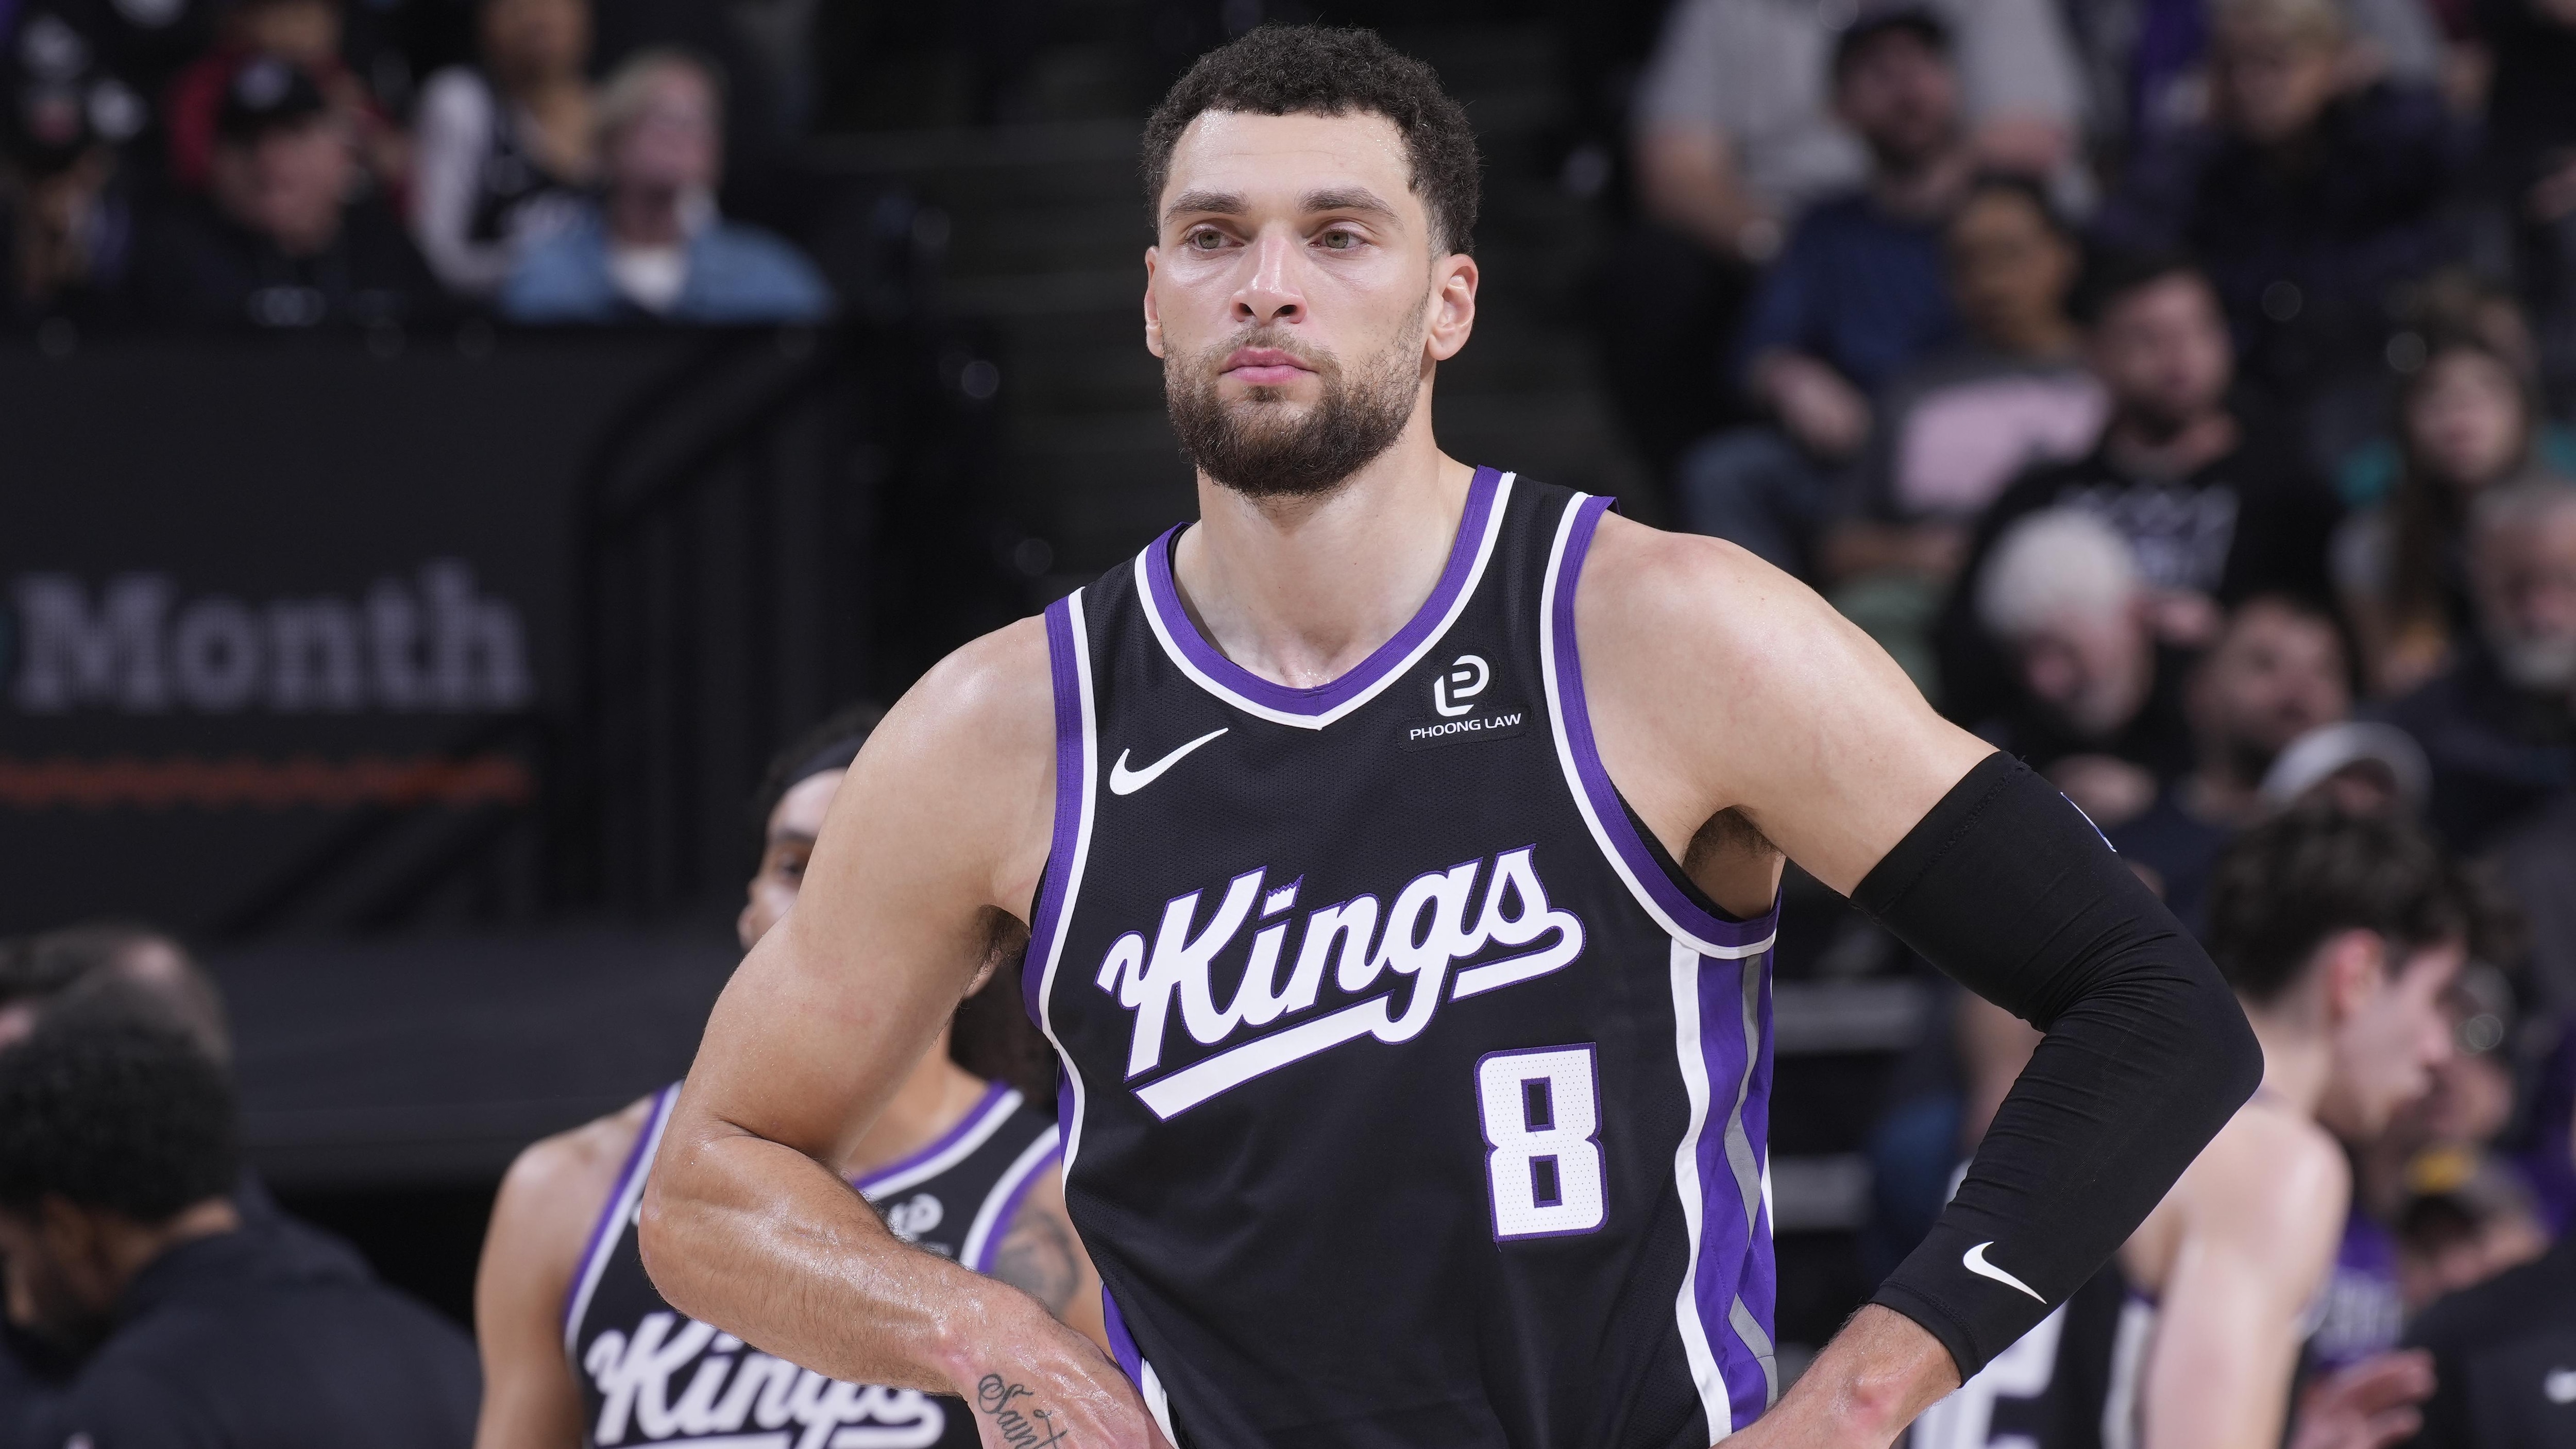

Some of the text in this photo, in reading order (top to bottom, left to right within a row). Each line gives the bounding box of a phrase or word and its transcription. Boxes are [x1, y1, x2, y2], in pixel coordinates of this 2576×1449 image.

[14, 558, 531, 711] Month
[1410, 713, 1521, 740] PHOONG LAW
[1093, 844, 1586, 1123] Kings
[1474, 1043, 1609, 1242] 8
